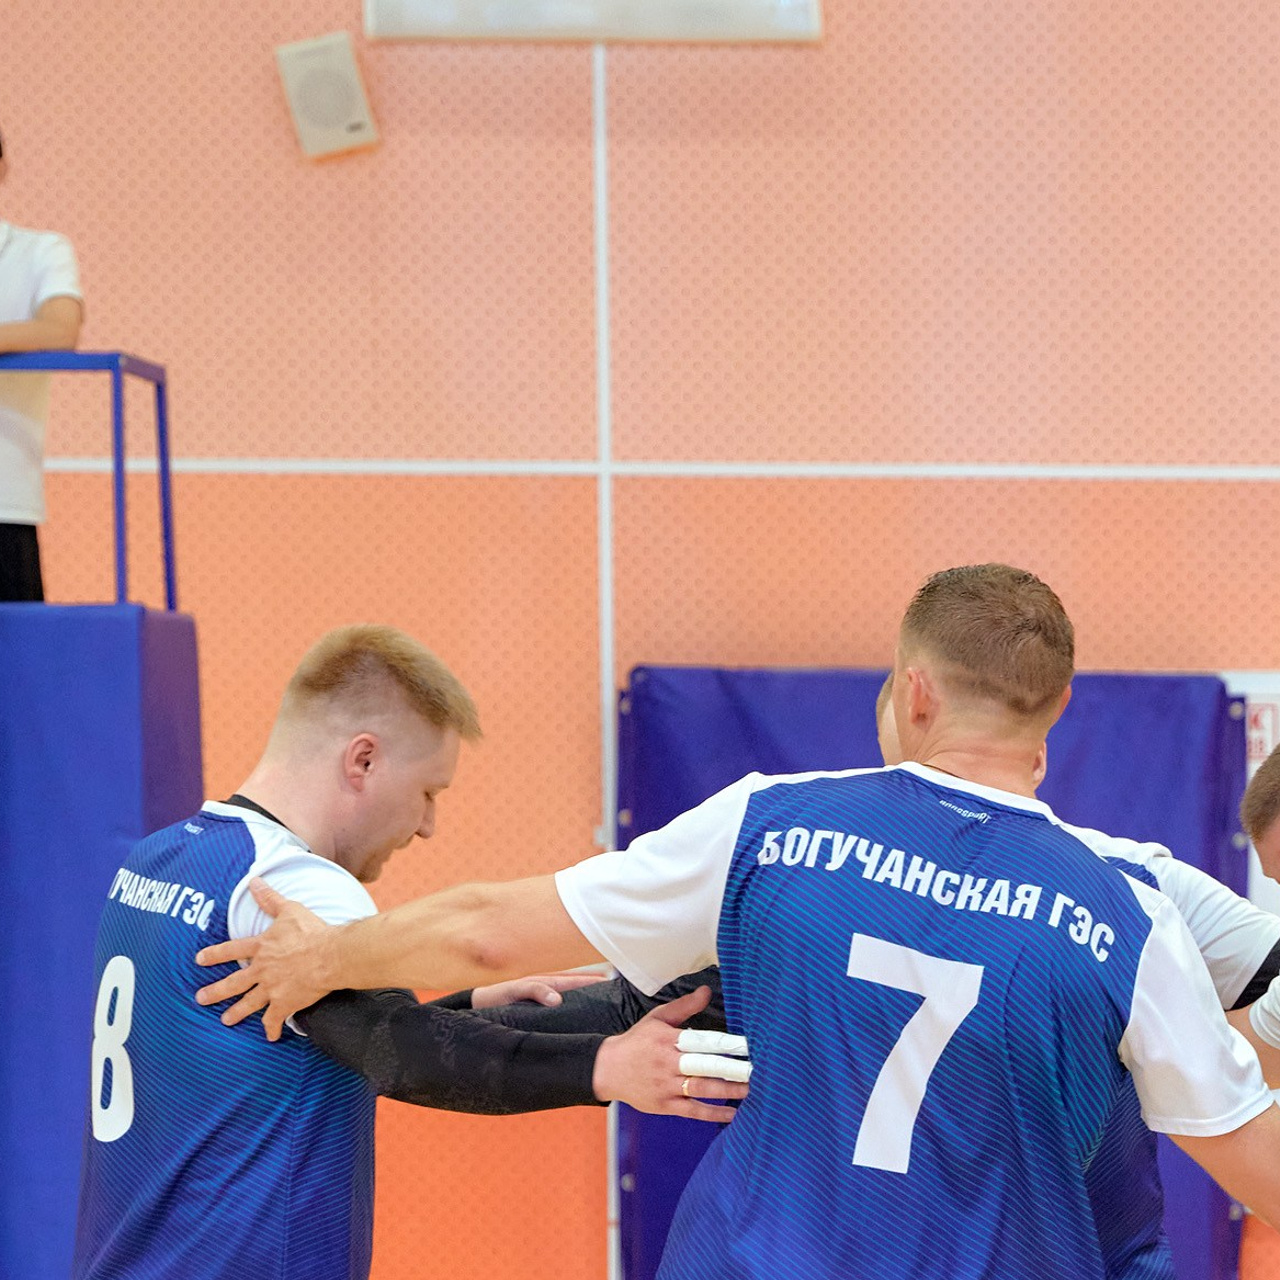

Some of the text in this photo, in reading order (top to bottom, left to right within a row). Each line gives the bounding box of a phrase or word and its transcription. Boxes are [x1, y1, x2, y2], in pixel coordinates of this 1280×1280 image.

[170, 886, 215, 931] ГЭС
[757, 827, 1115, 962] БОГУЧАНСКАЯ ГЭС
[91, 955, 135, 1143] 8
[846, 932, 985, 1175] 7
